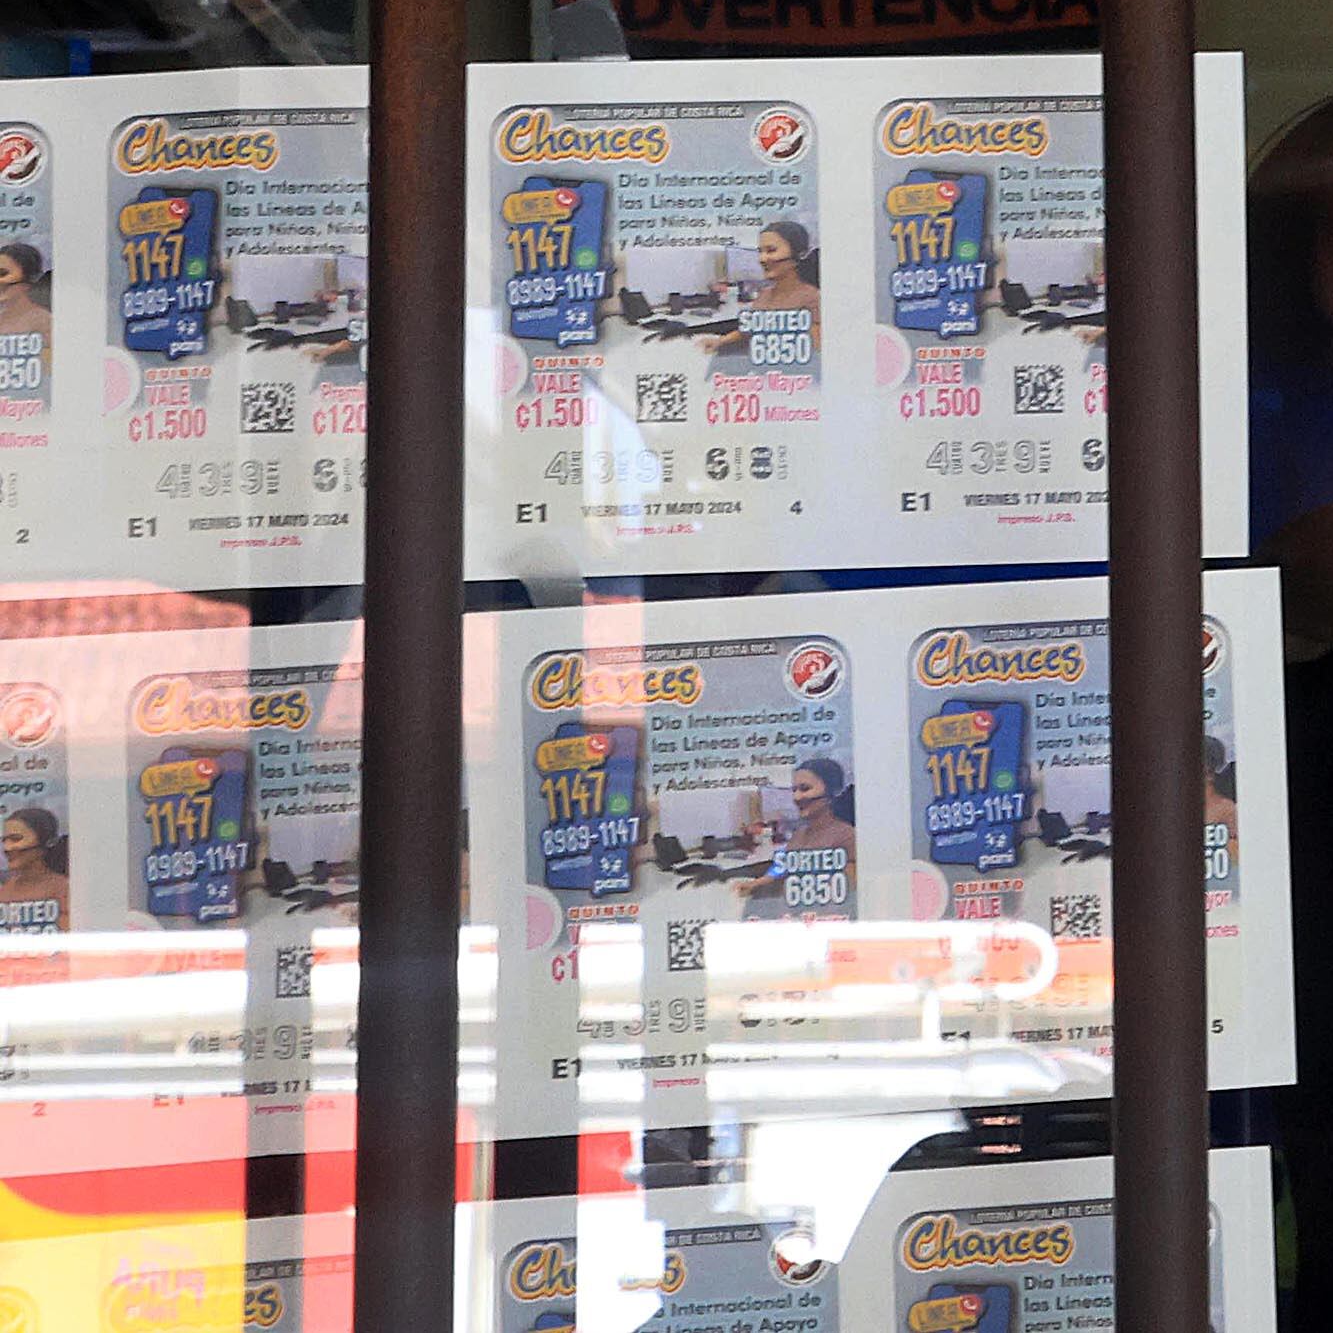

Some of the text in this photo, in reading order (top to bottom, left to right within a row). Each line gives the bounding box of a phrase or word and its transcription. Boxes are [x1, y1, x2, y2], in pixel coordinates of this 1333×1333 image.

[119, 120, 282, 171] Chances
[502, 111, 669, 163] Chances
[885, 104, 1049, 156] Chances
[121, 234, 184, 285] 1147
[507, 224, 572, 273] 1147
[890, 216, 954, 265] 1147
[739, 307, 810, 333] SORTEO
[749, 332, 811, 365] 6850
[143, 384, 190, 407] VALE
[126, 514, 155, 539] E1
[515, 498, 552, 523] E1
[901, 490, 933, 516] E1
[919, 632, 1086, 683] Chances
[540, 770, 606, 823] 1147
[926, 746, 991, 798] 1147
[145, 795, 214, 847] 1147
[774, 846, 846, 876] SORTEO
[784, 872, 847, 908] 6850
[905, 1215, 1075, 1267] Chances
